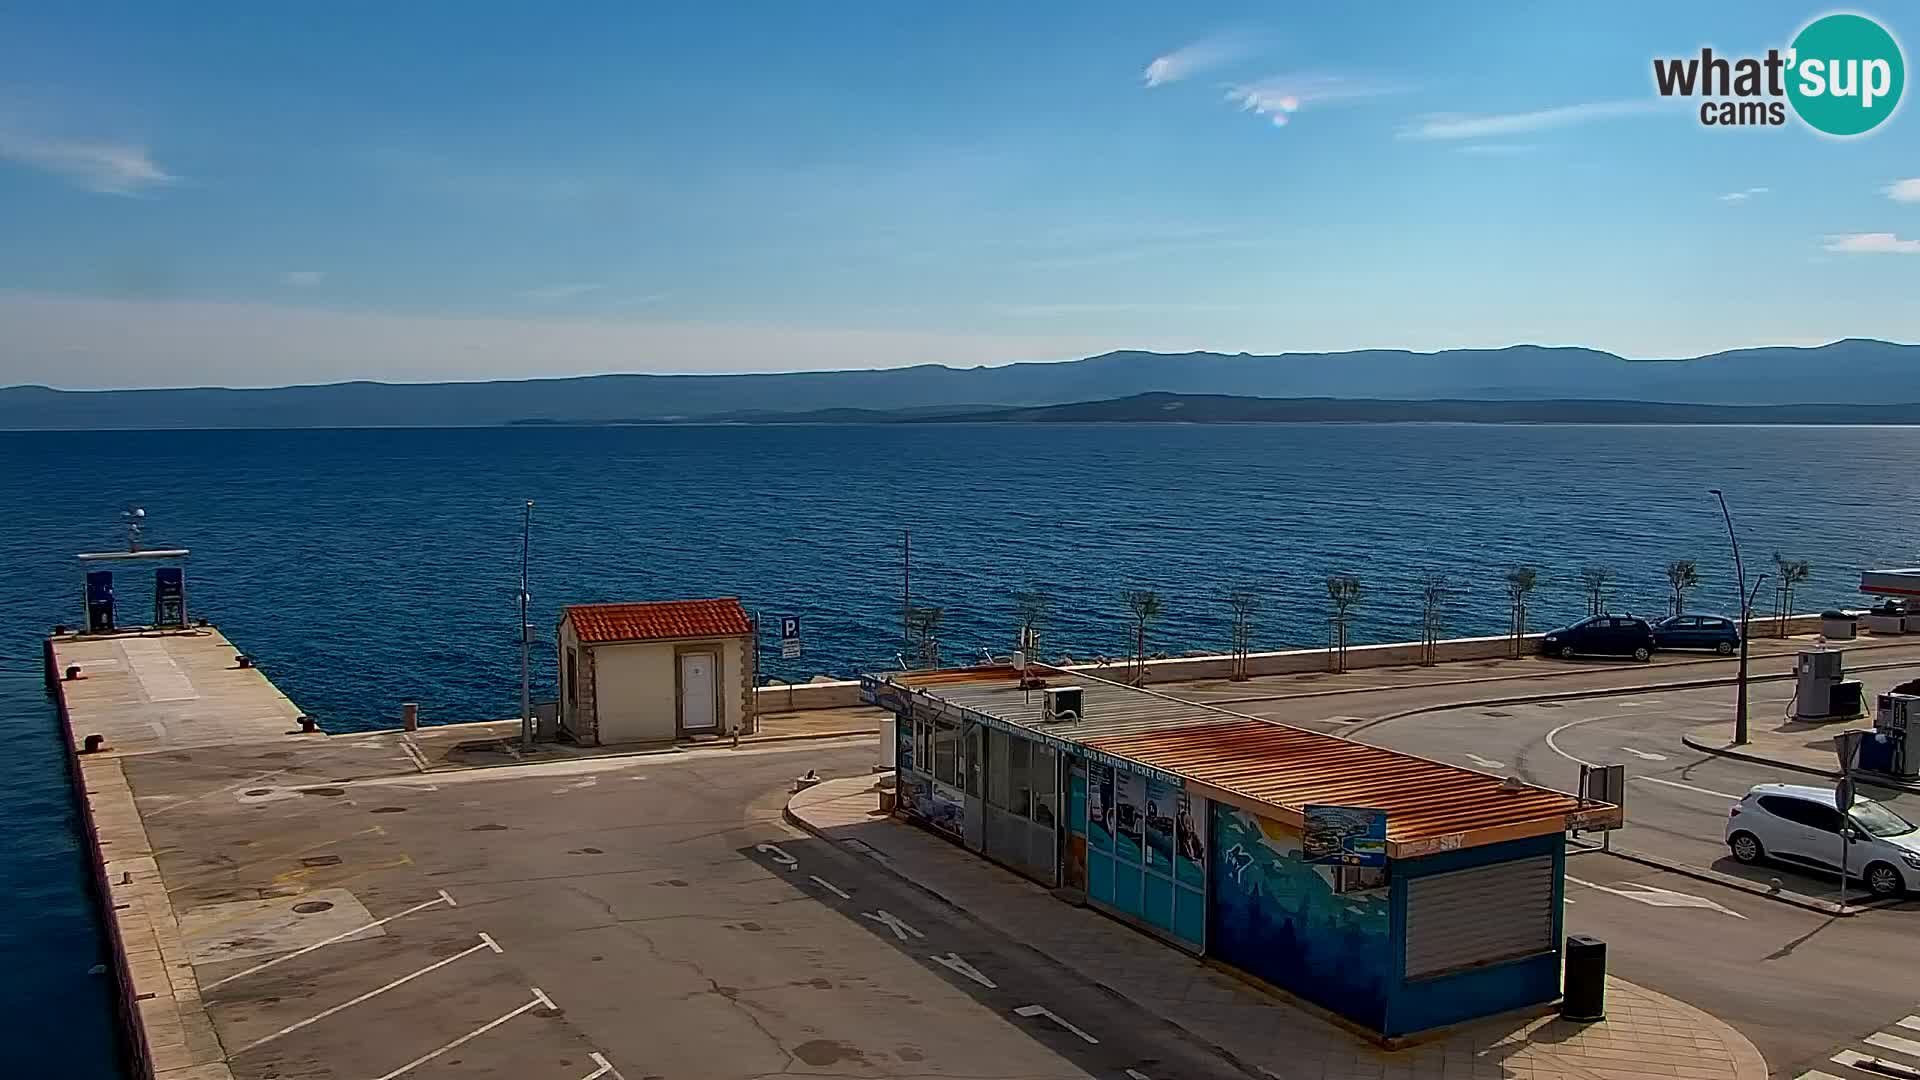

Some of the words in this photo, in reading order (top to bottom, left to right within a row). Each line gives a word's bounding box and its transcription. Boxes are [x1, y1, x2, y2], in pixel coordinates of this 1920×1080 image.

[786, 620, 796, 636] P
[1083, 747, 1098, 760] BUS
[1098, 752, 1128, 770] STATION
[1130, 763, 1155, 779] TICKET
[1156, 771, 1181, 787] OFFICE
